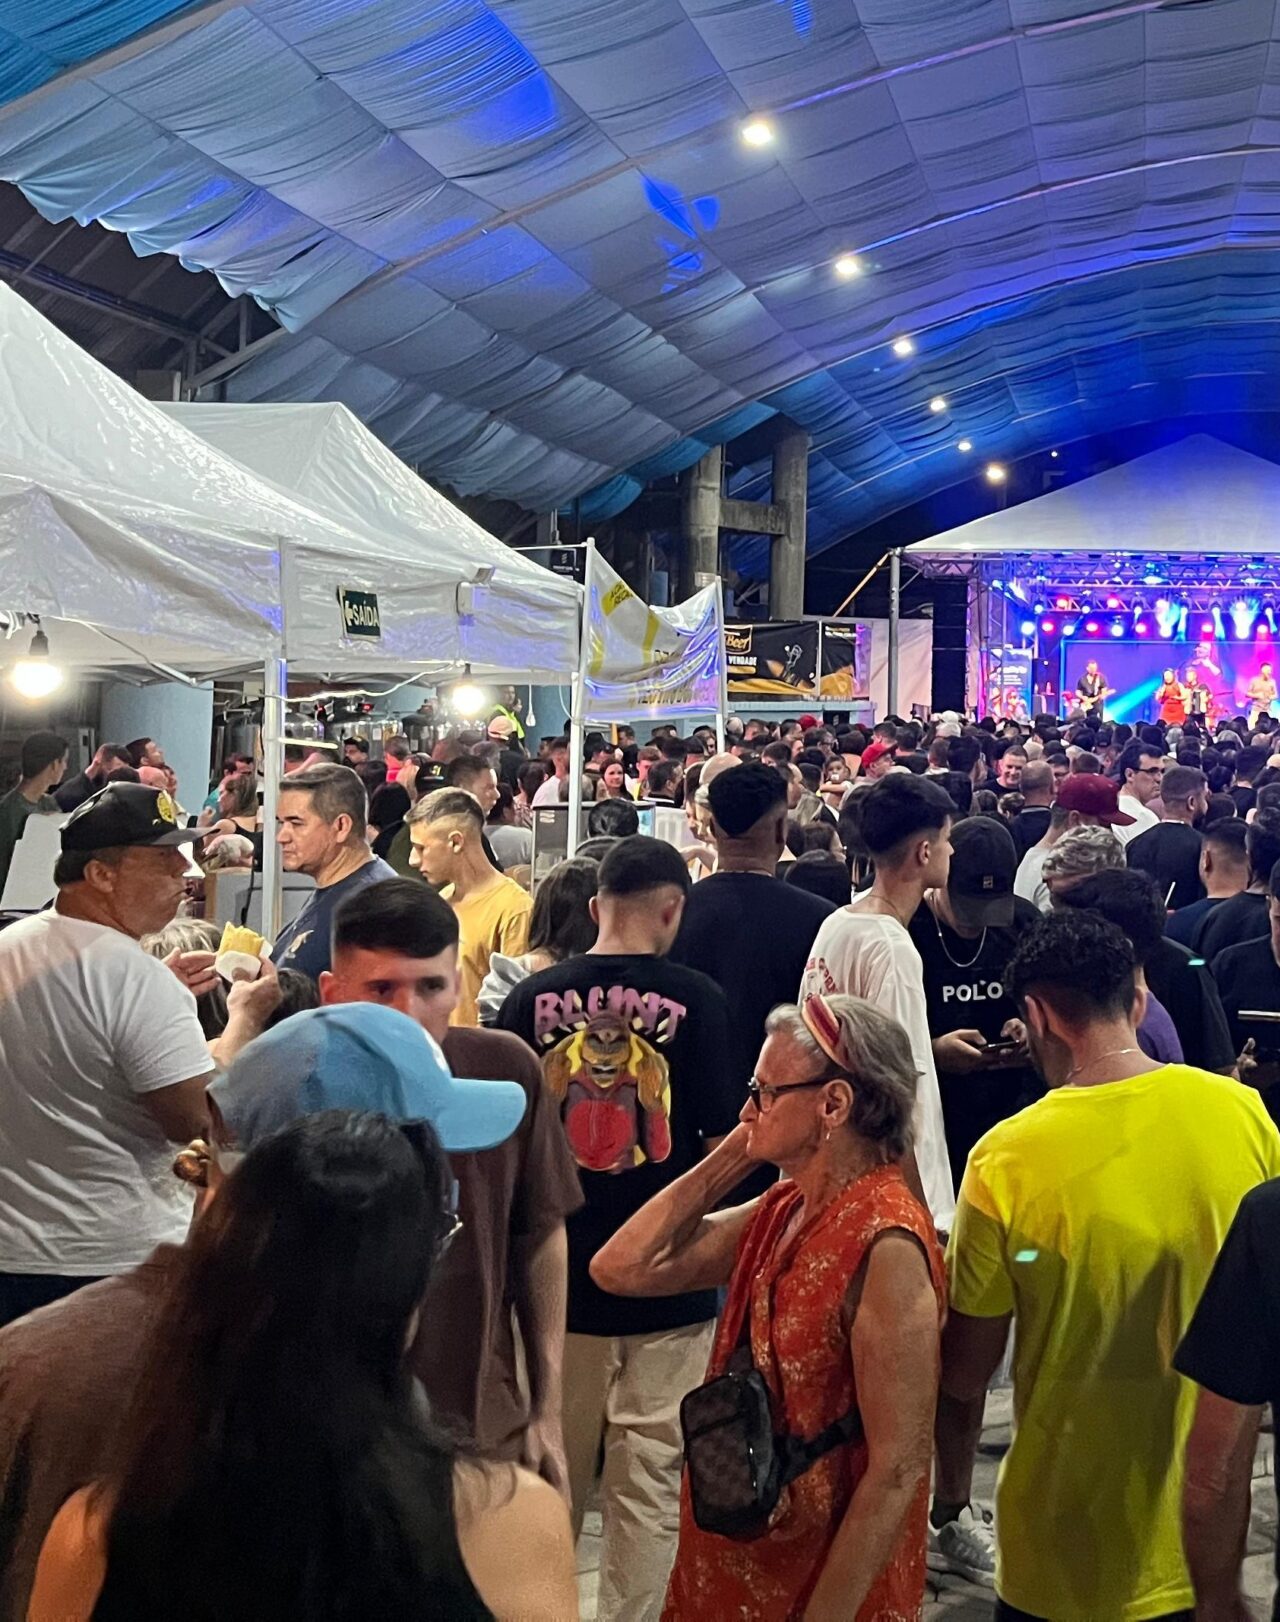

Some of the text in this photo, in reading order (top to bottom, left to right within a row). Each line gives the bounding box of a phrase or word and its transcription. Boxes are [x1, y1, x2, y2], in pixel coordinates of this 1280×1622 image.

[352, 600, 380, 627] SAÍDA
[942, 981, 1003, 1002] POLO
[535, 985, 687, 1044] BLUNT
